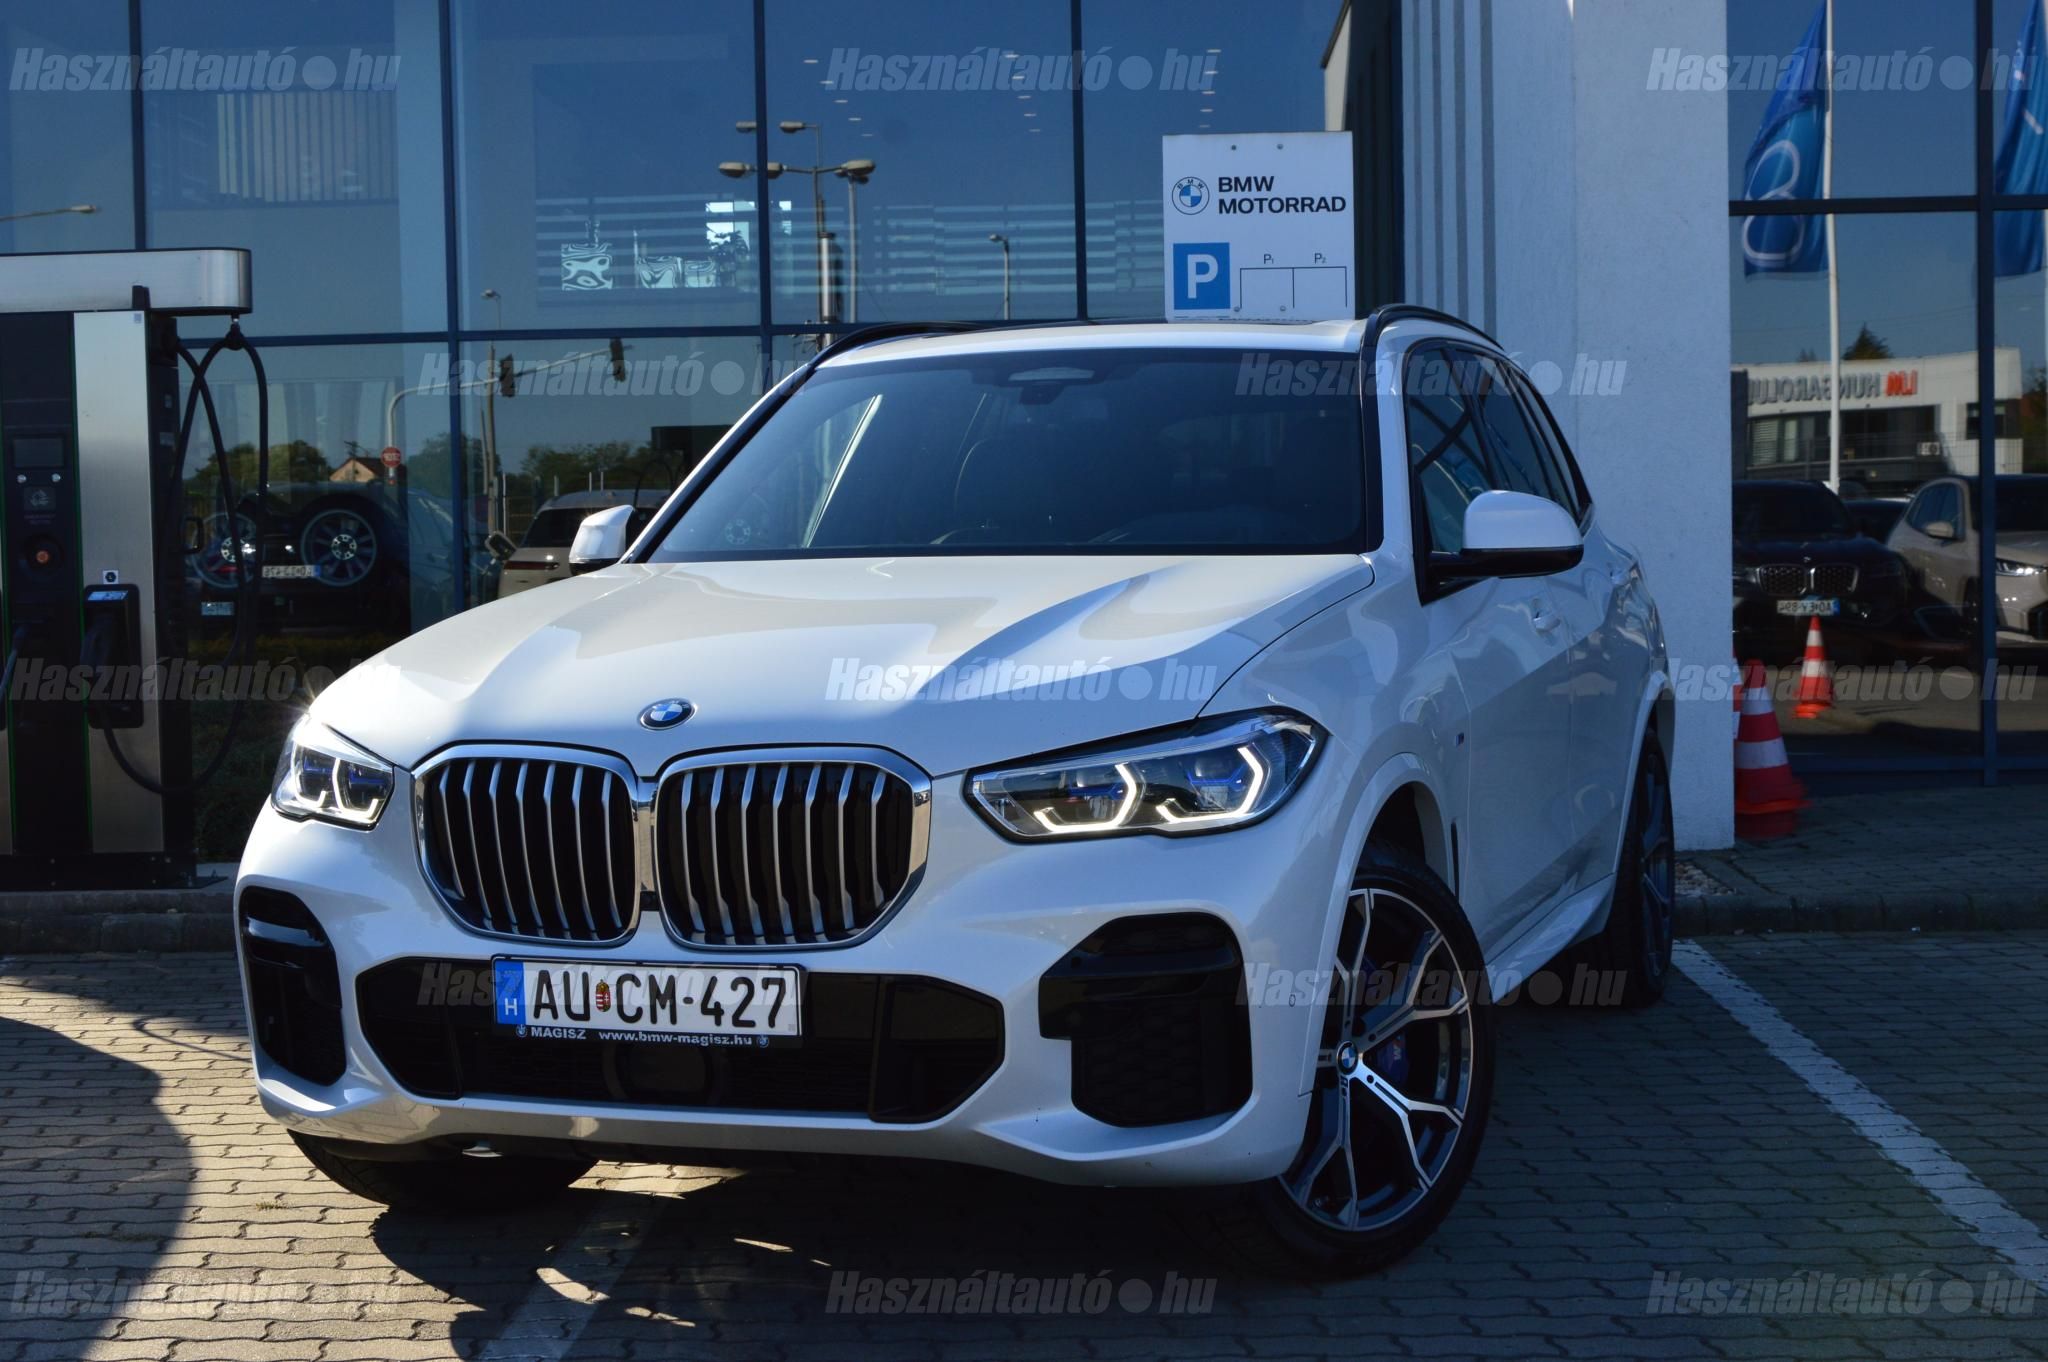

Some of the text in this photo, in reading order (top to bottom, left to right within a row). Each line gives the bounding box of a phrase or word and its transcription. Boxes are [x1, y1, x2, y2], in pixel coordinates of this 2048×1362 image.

[1218, 175, 1275, 192] BMW
[1218, 196, 1346, 214] MOTORRAD
[1187, 253, 1218, 299] P
[504, 997, 518, 1017] H
[531, 1026, 753, 1046] MAGISZ www.bmw-magisz.hu
